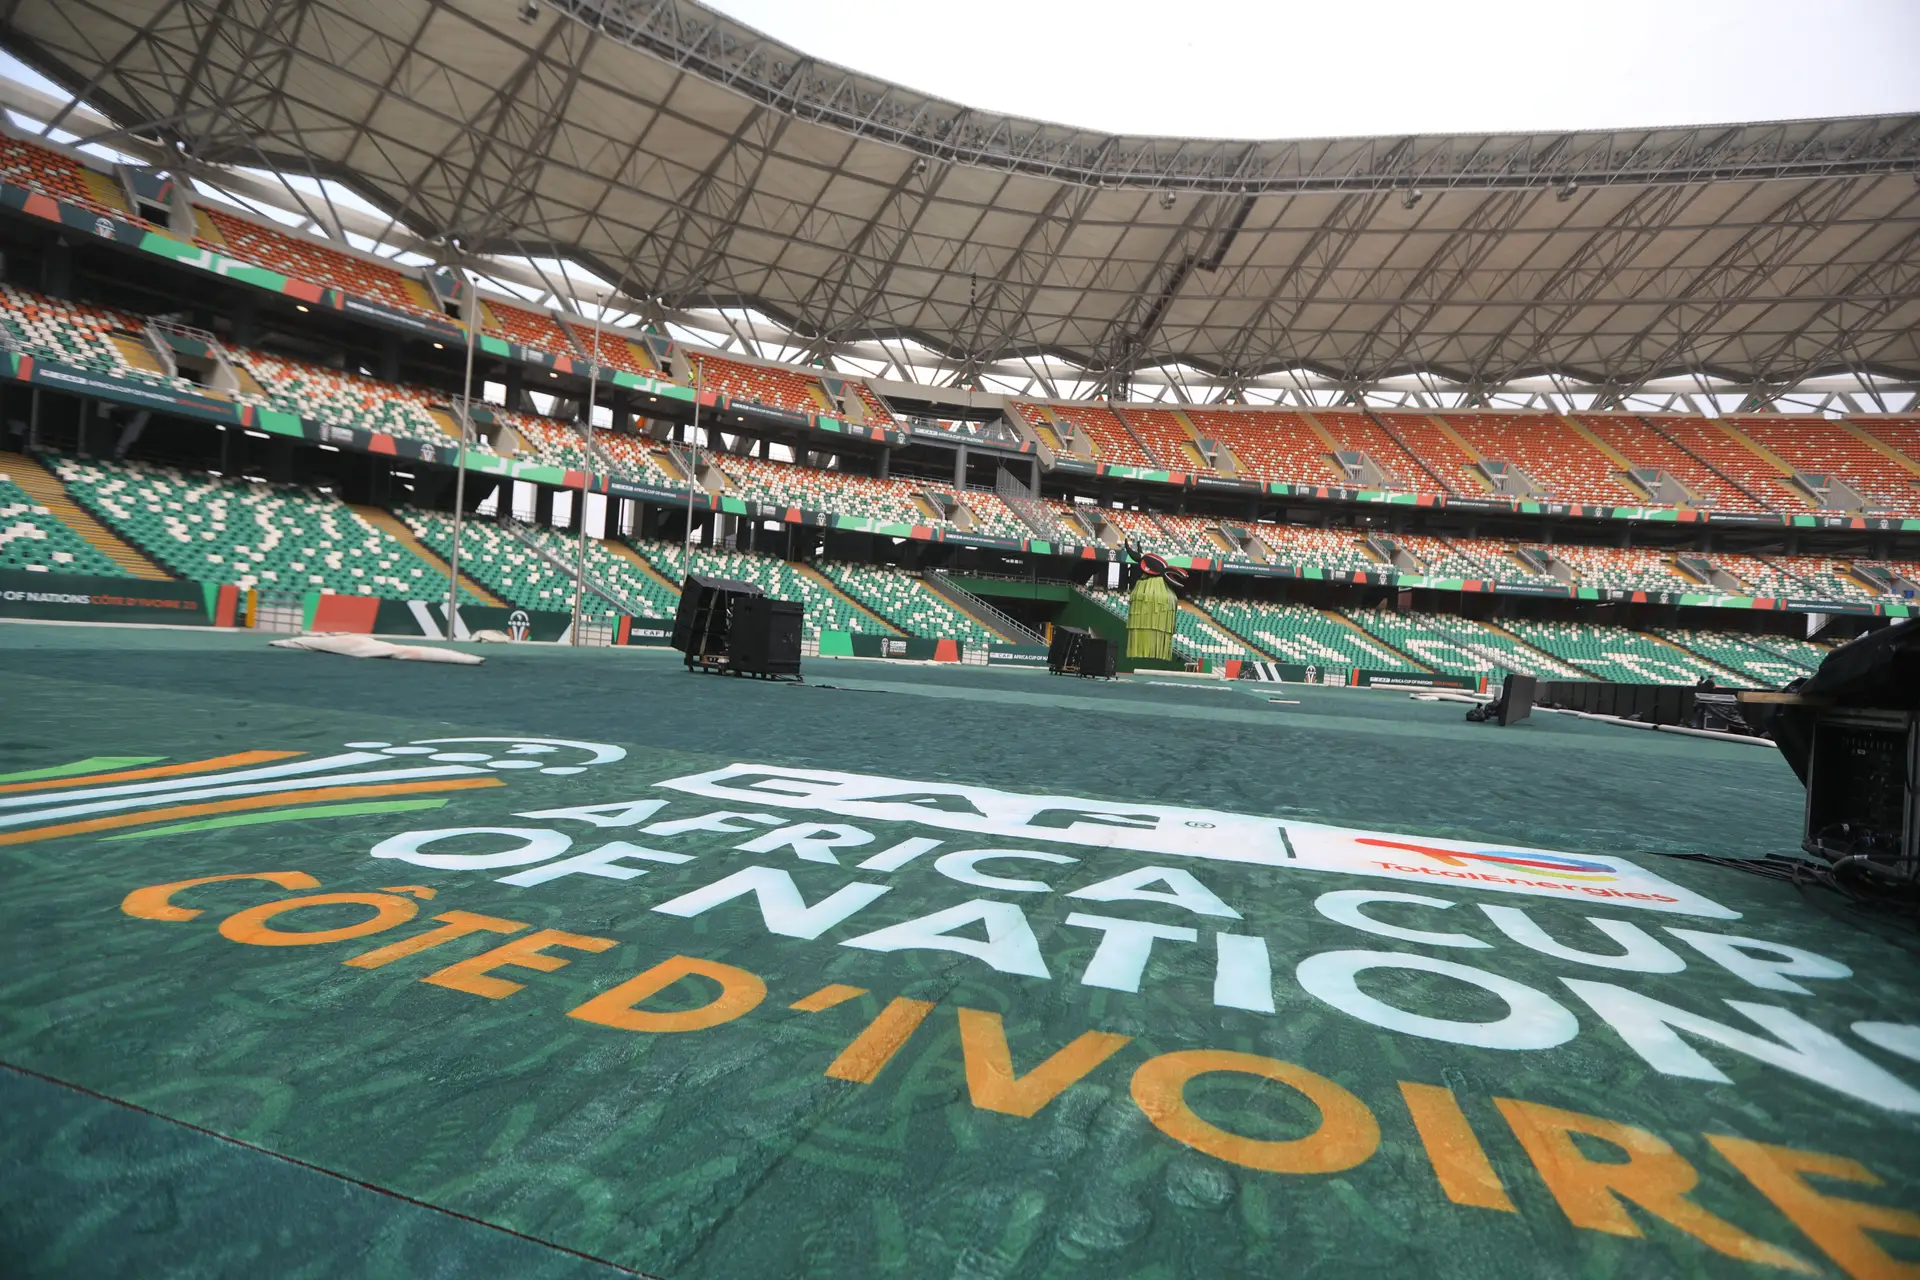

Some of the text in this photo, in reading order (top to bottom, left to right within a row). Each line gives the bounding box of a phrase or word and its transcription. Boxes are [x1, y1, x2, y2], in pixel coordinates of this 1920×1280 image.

[3, 591, 26, 600] OF
[27, 593, 90, 604] NATIONS
[370, 826, 697, 887] OF
[1371, 861, 1680, 903] TotalEnergies
[512, 799, 1853, 995] AFRICA CUP
[121, 871, 1920, 1280] CÔTE D'IVOIRE
